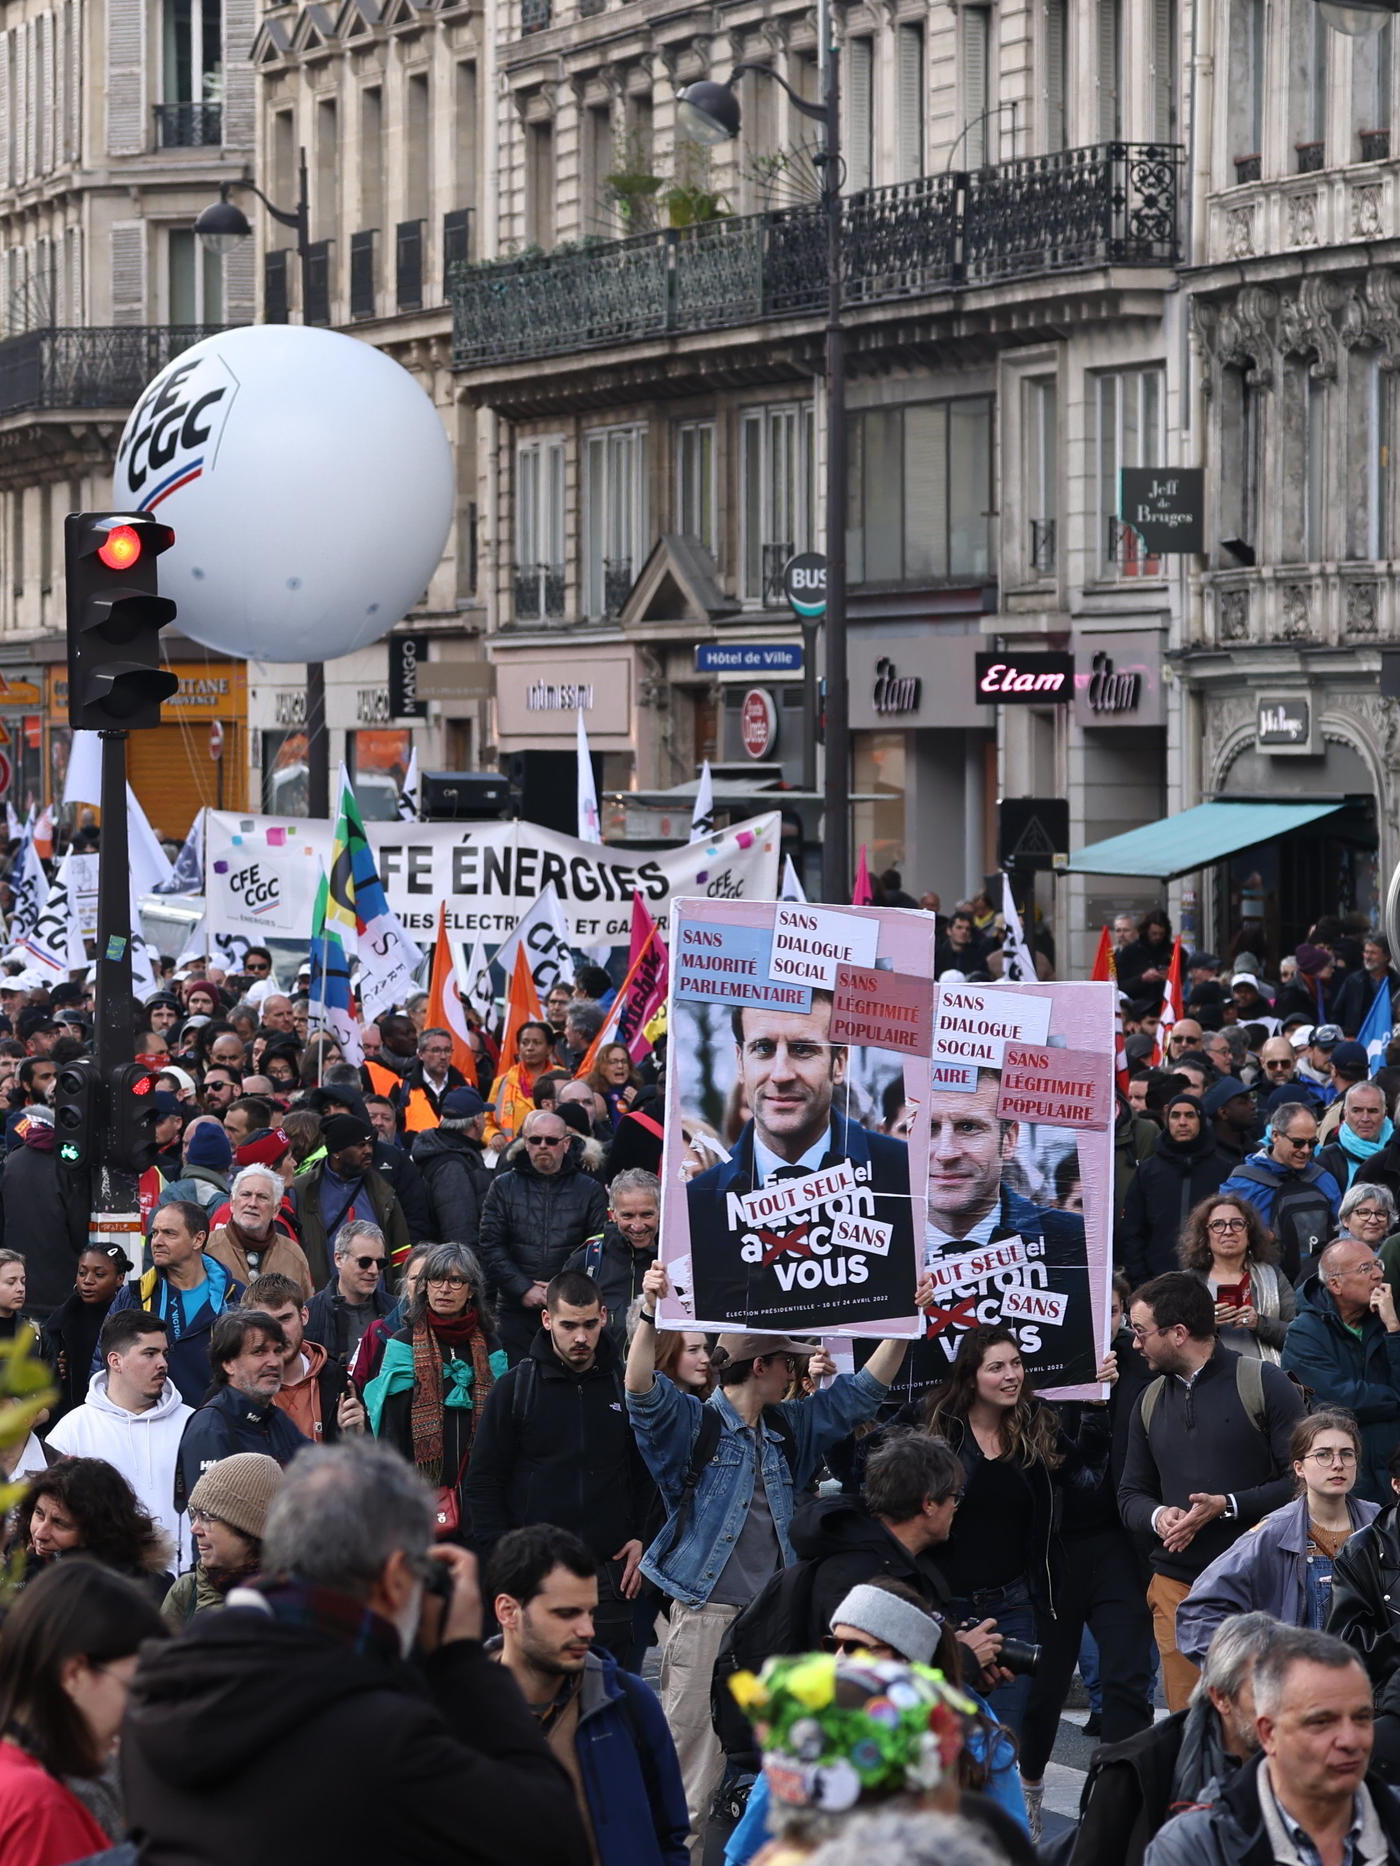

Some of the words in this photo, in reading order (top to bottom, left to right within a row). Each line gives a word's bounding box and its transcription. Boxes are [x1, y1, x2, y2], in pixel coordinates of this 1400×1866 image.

[119, 356, 204, 462] FE
[128, 386, 227, 493] CGC
[1148, 480, 1179, 498] Jeff
[1157, 498, 1170, 508] de
[1137, 505, 1193, 527] Bruges
[792, 568, 827, 589] BUS
[707, 652, 742, 665] Hôtel
[745, 652, 760, 664] de
[764, 651, 793, 664] Ville
[178, 678, 230, 694] ITANE
[402, 640, 416, 713] MANGO
[981, 664, 1065, 692] Etam
[230, 863, 260, 892] CFE
[379, 846, 433, 894] FE
[452, 833, 669, 902] ÉNERGIES
[245, 877, 280, 907] CGC
[707, 868, 732, 898] CFE
[576, 919, 600, 935] ET
[779, 911, 818, 931] SANS
[683, 930, 723, 947] SANS
[777, 934, 853, 962] DIALOGUE
[681, 953, 757, 976] MAJORITÉ
[774, 958, 828, 981] SOCIAL
[680, 976, 806, 1005] PARLEMENTAIRE
[839, 972, 879, 992] SANS
[837, 995, 921, 1024] LÉGITIMITÉ
[942, 993, 985, 1011] SANS
[834, 1019, 919, 1047] POPULAIRE
[940, 1015, 1023, 1040] DIALOGUE
[937, 1039, 995, 1060] SOCIAL
[1008, 1051, 1049, 1069] SANS
[933, 1068, 971, 1084] AIRE
[1005, 1073, 1096, 1099] LÉGITIMITÉ
[1002, 1097, 1094, 1121] POPULAIRE
[746, 1188, 796, 1220] TOUT
[803, 1173, 852, 1201] SEUL
[837, 1221, 886, 1248] SANS
[774, 1255, 869, 1292] vous
[931, 1262, 963, 1288] OUT
[971, 1245, 1024, 1274] SEUL
[726, 1309, 759, 1318] ÉLECTION
[761, 1303, 815, 1315] PRÉSIDENTIELLE
[1007, 1293, 1060, 1318] SANS
[938, 1325, 1042, 1363] vs
